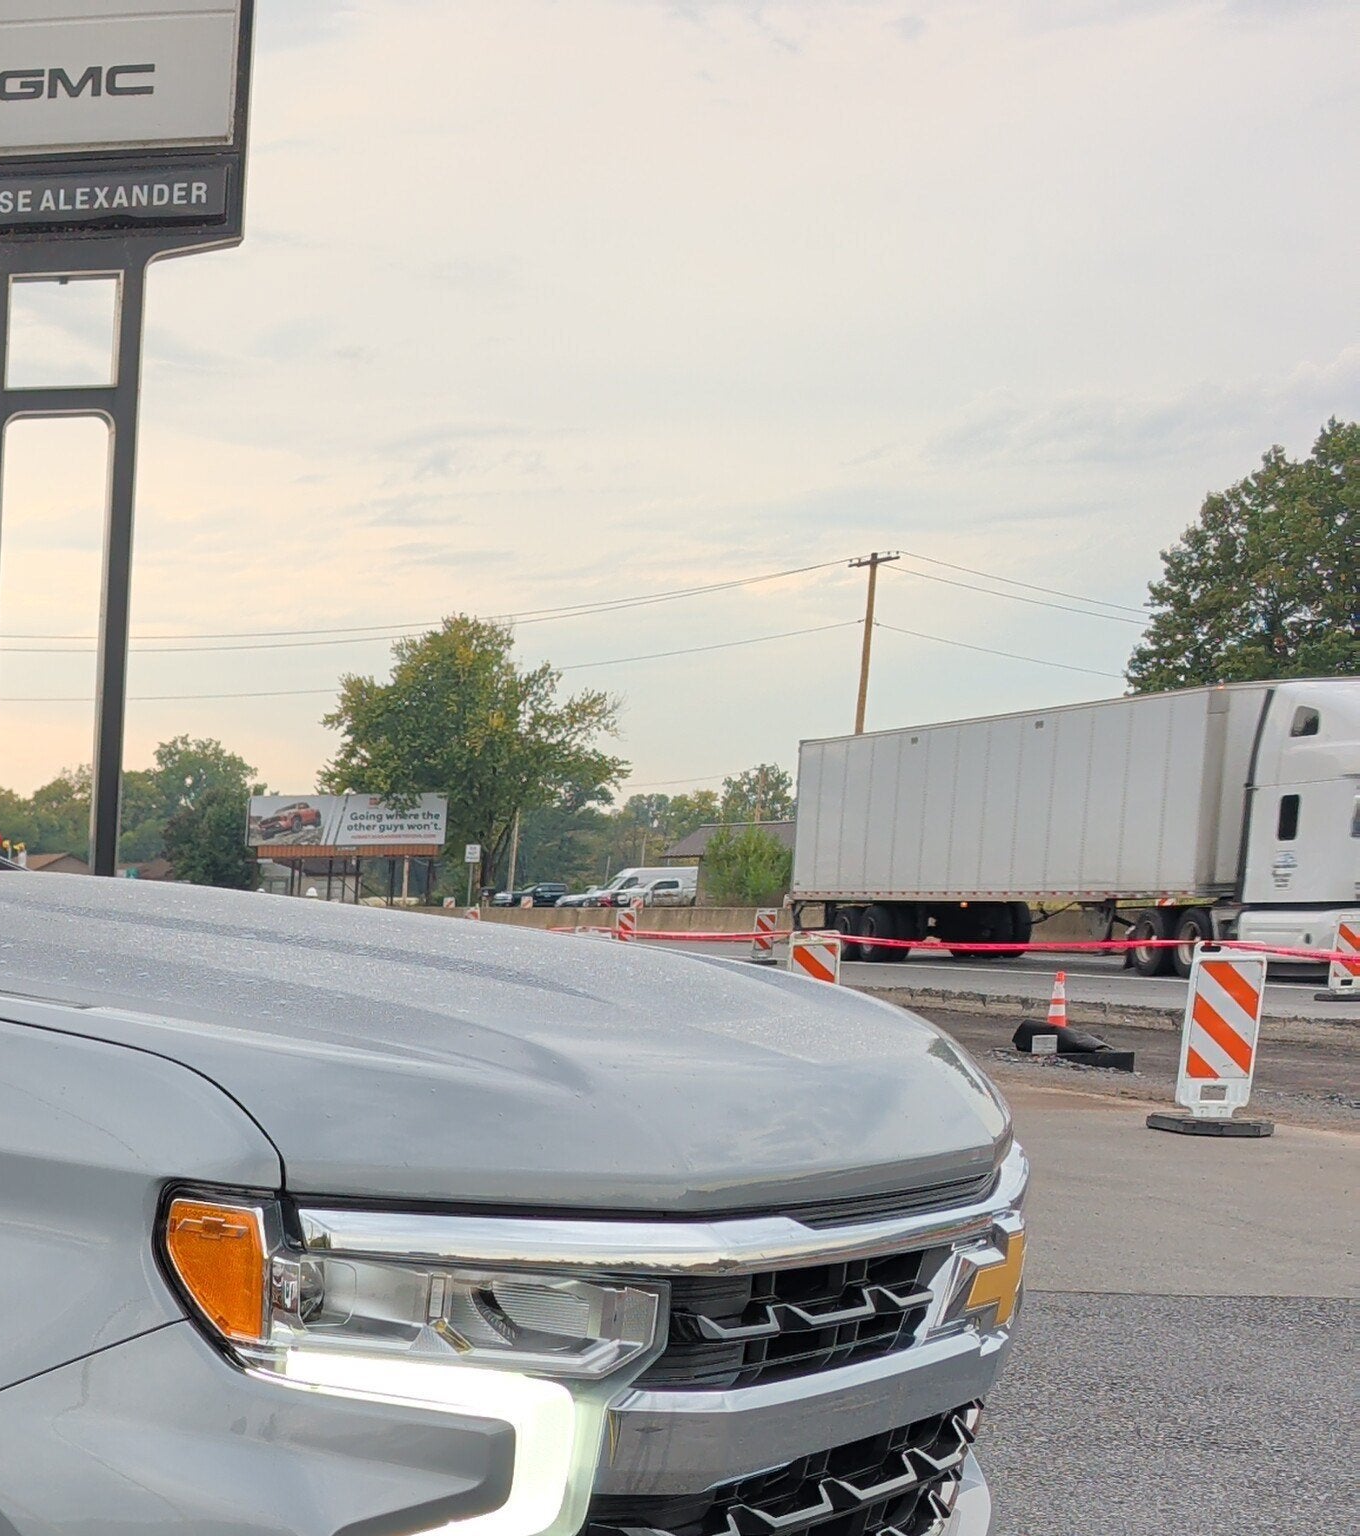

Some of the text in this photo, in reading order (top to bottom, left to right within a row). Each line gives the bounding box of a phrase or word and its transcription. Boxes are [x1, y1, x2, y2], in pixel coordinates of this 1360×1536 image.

[39, 182, 209, 212] ALEXANDER
[350, 812, 383, 822] Going
[422, 811, 440, 820] the
[347, 821, 442, 832] other guys won't.
